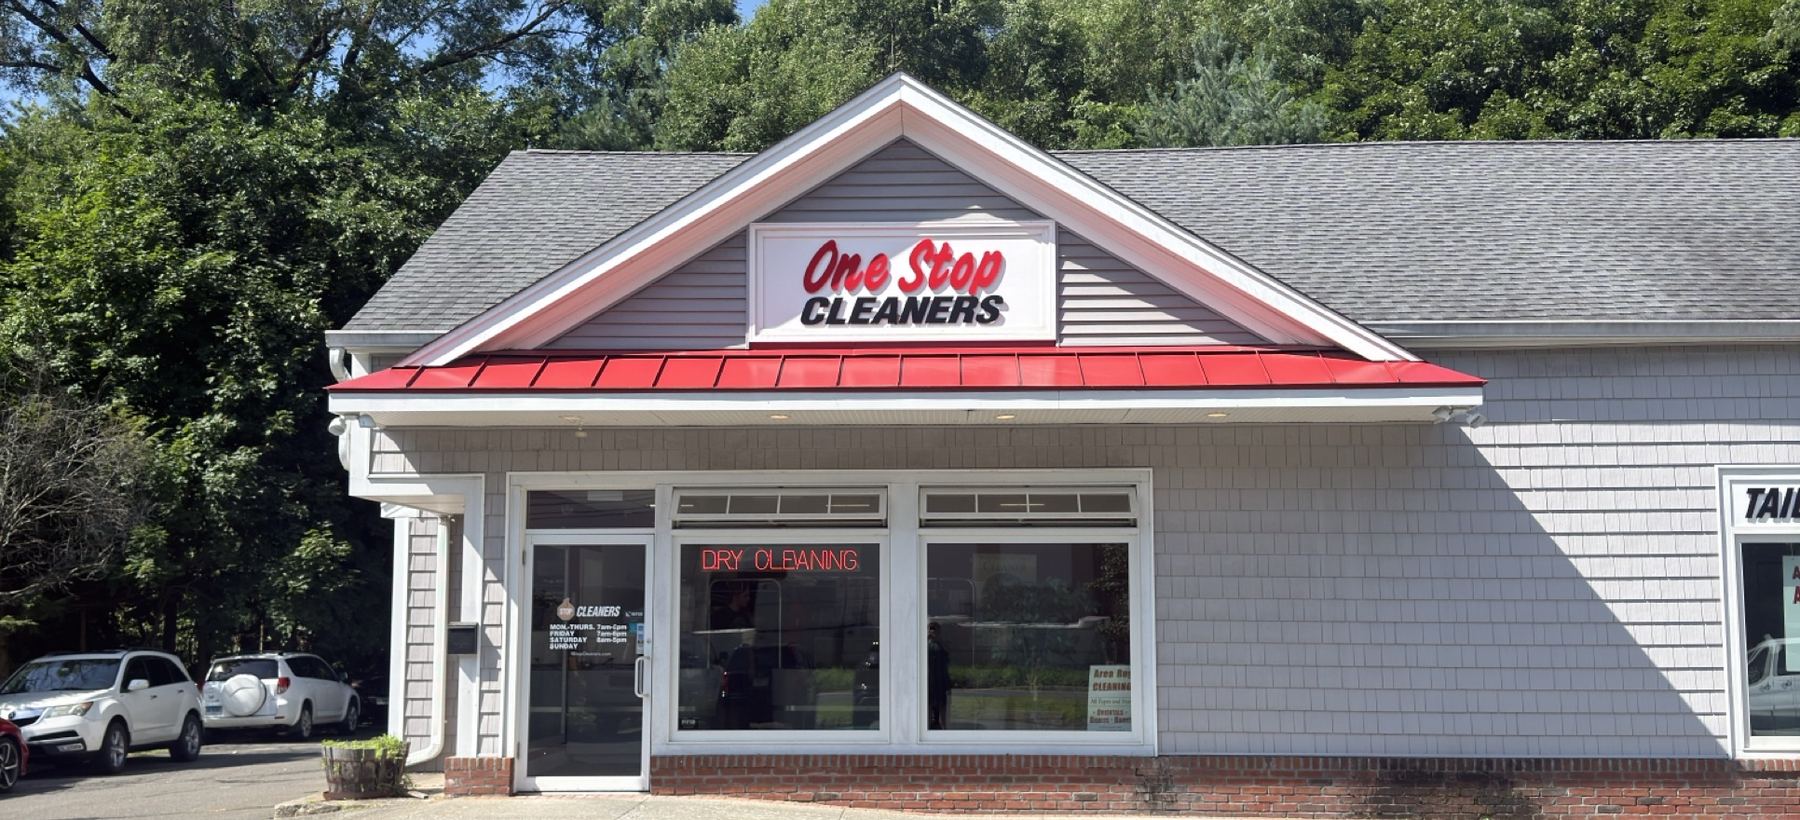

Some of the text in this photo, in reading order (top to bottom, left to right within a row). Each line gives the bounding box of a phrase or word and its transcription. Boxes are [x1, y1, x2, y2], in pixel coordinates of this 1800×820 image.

[803, 238, 1004, 296] One Stop
[800, 295, 1005, 326] CLEANERS
[702, 549, 858, 571] DRY CLEANING
[576, 605, 621, 617] CLEANERS
